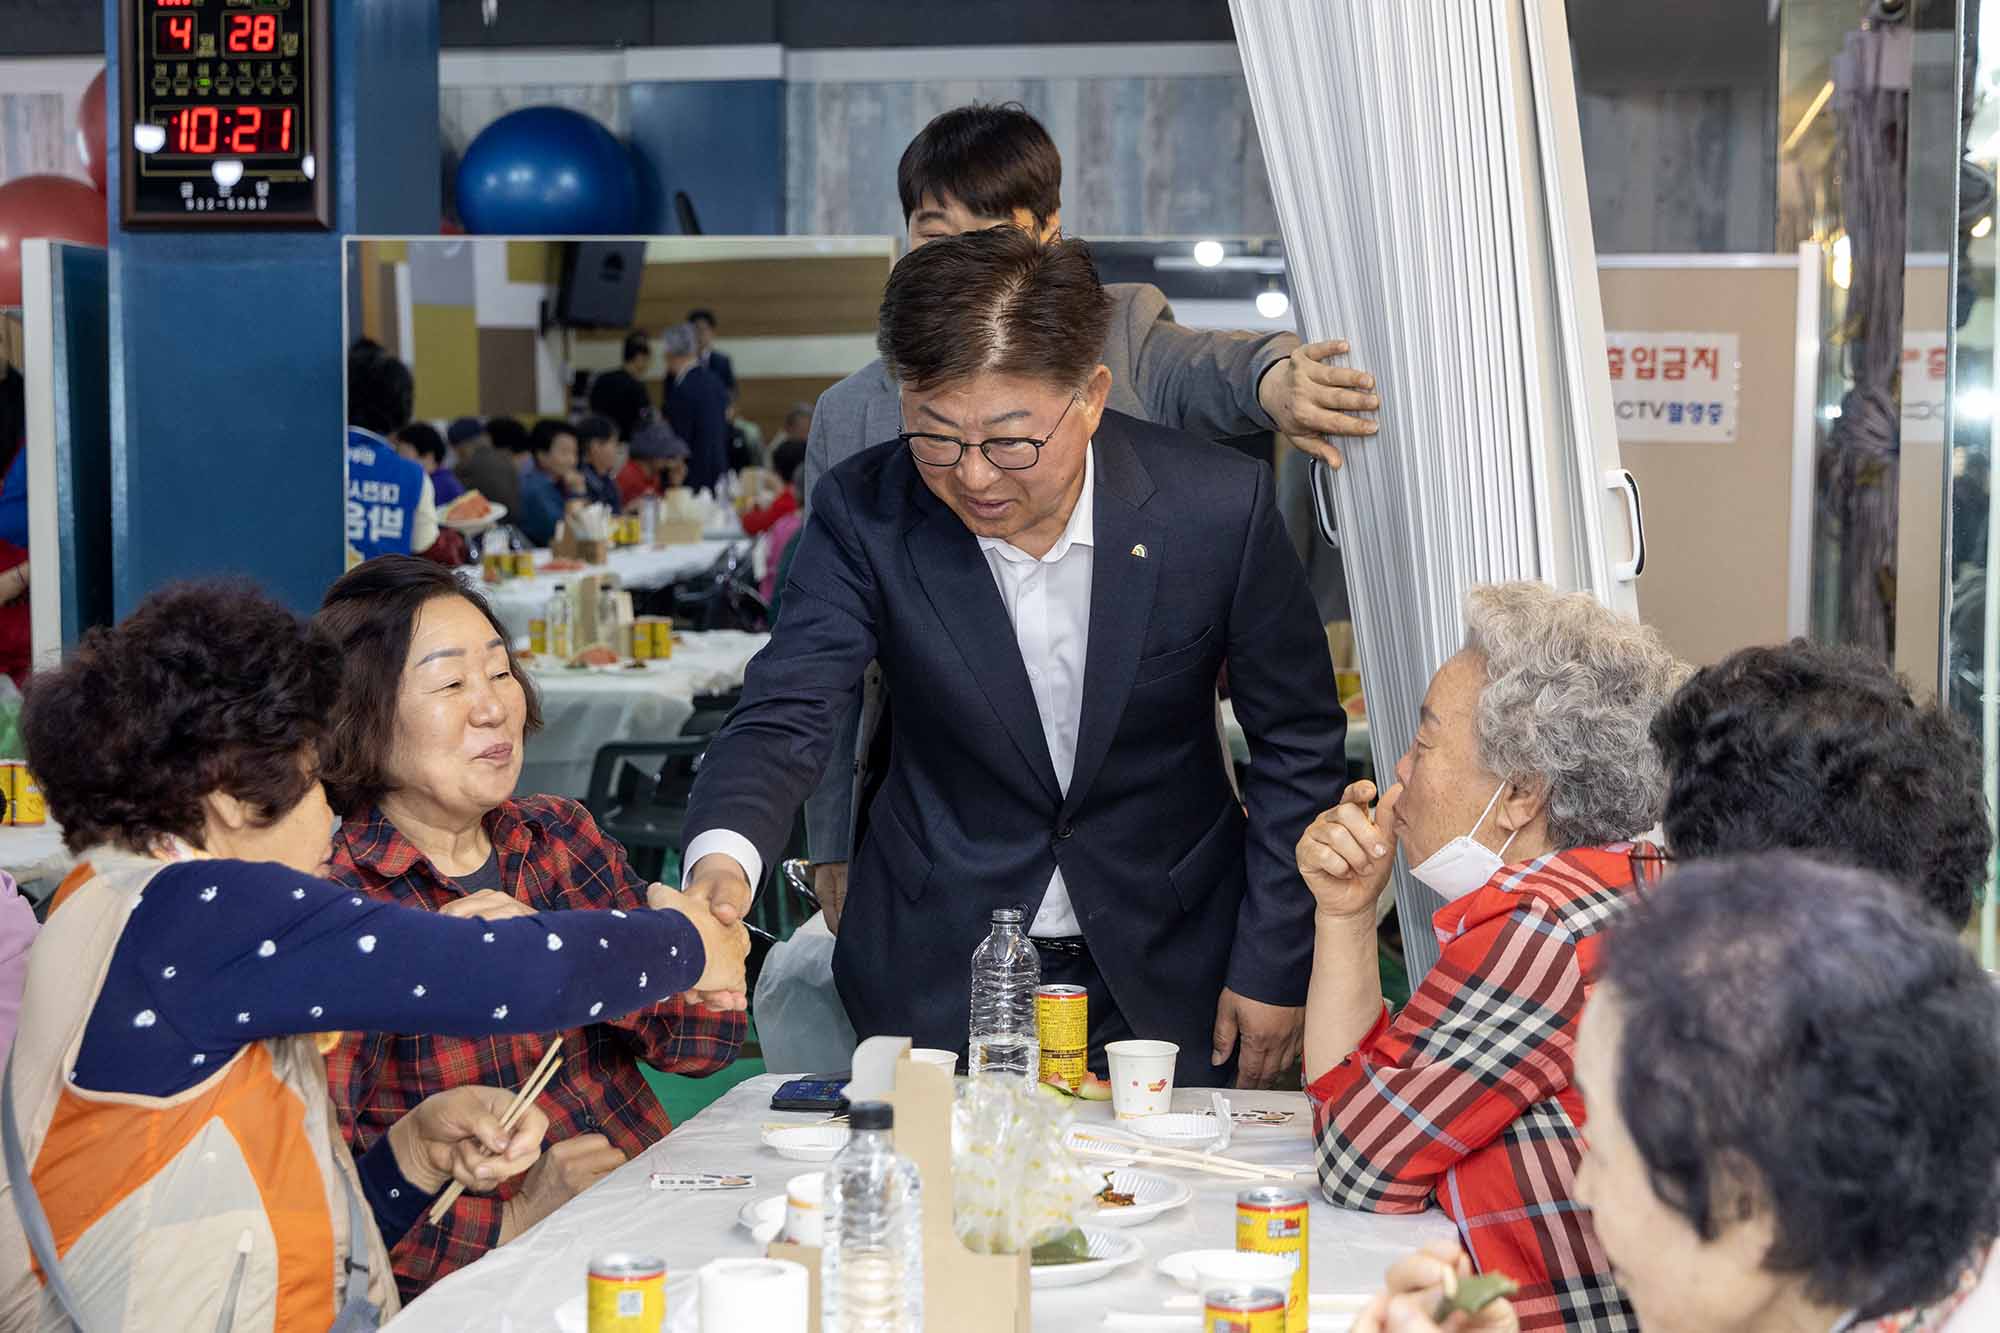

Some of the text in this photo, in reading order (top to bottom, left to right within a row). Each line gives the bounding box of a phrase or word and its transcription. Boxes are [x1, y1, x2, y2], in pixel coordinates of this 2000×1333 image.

[169, 17, 193, 49] 4
[229, 15, 276, 52] 28
[178, 106, 292, 153] 10:21
